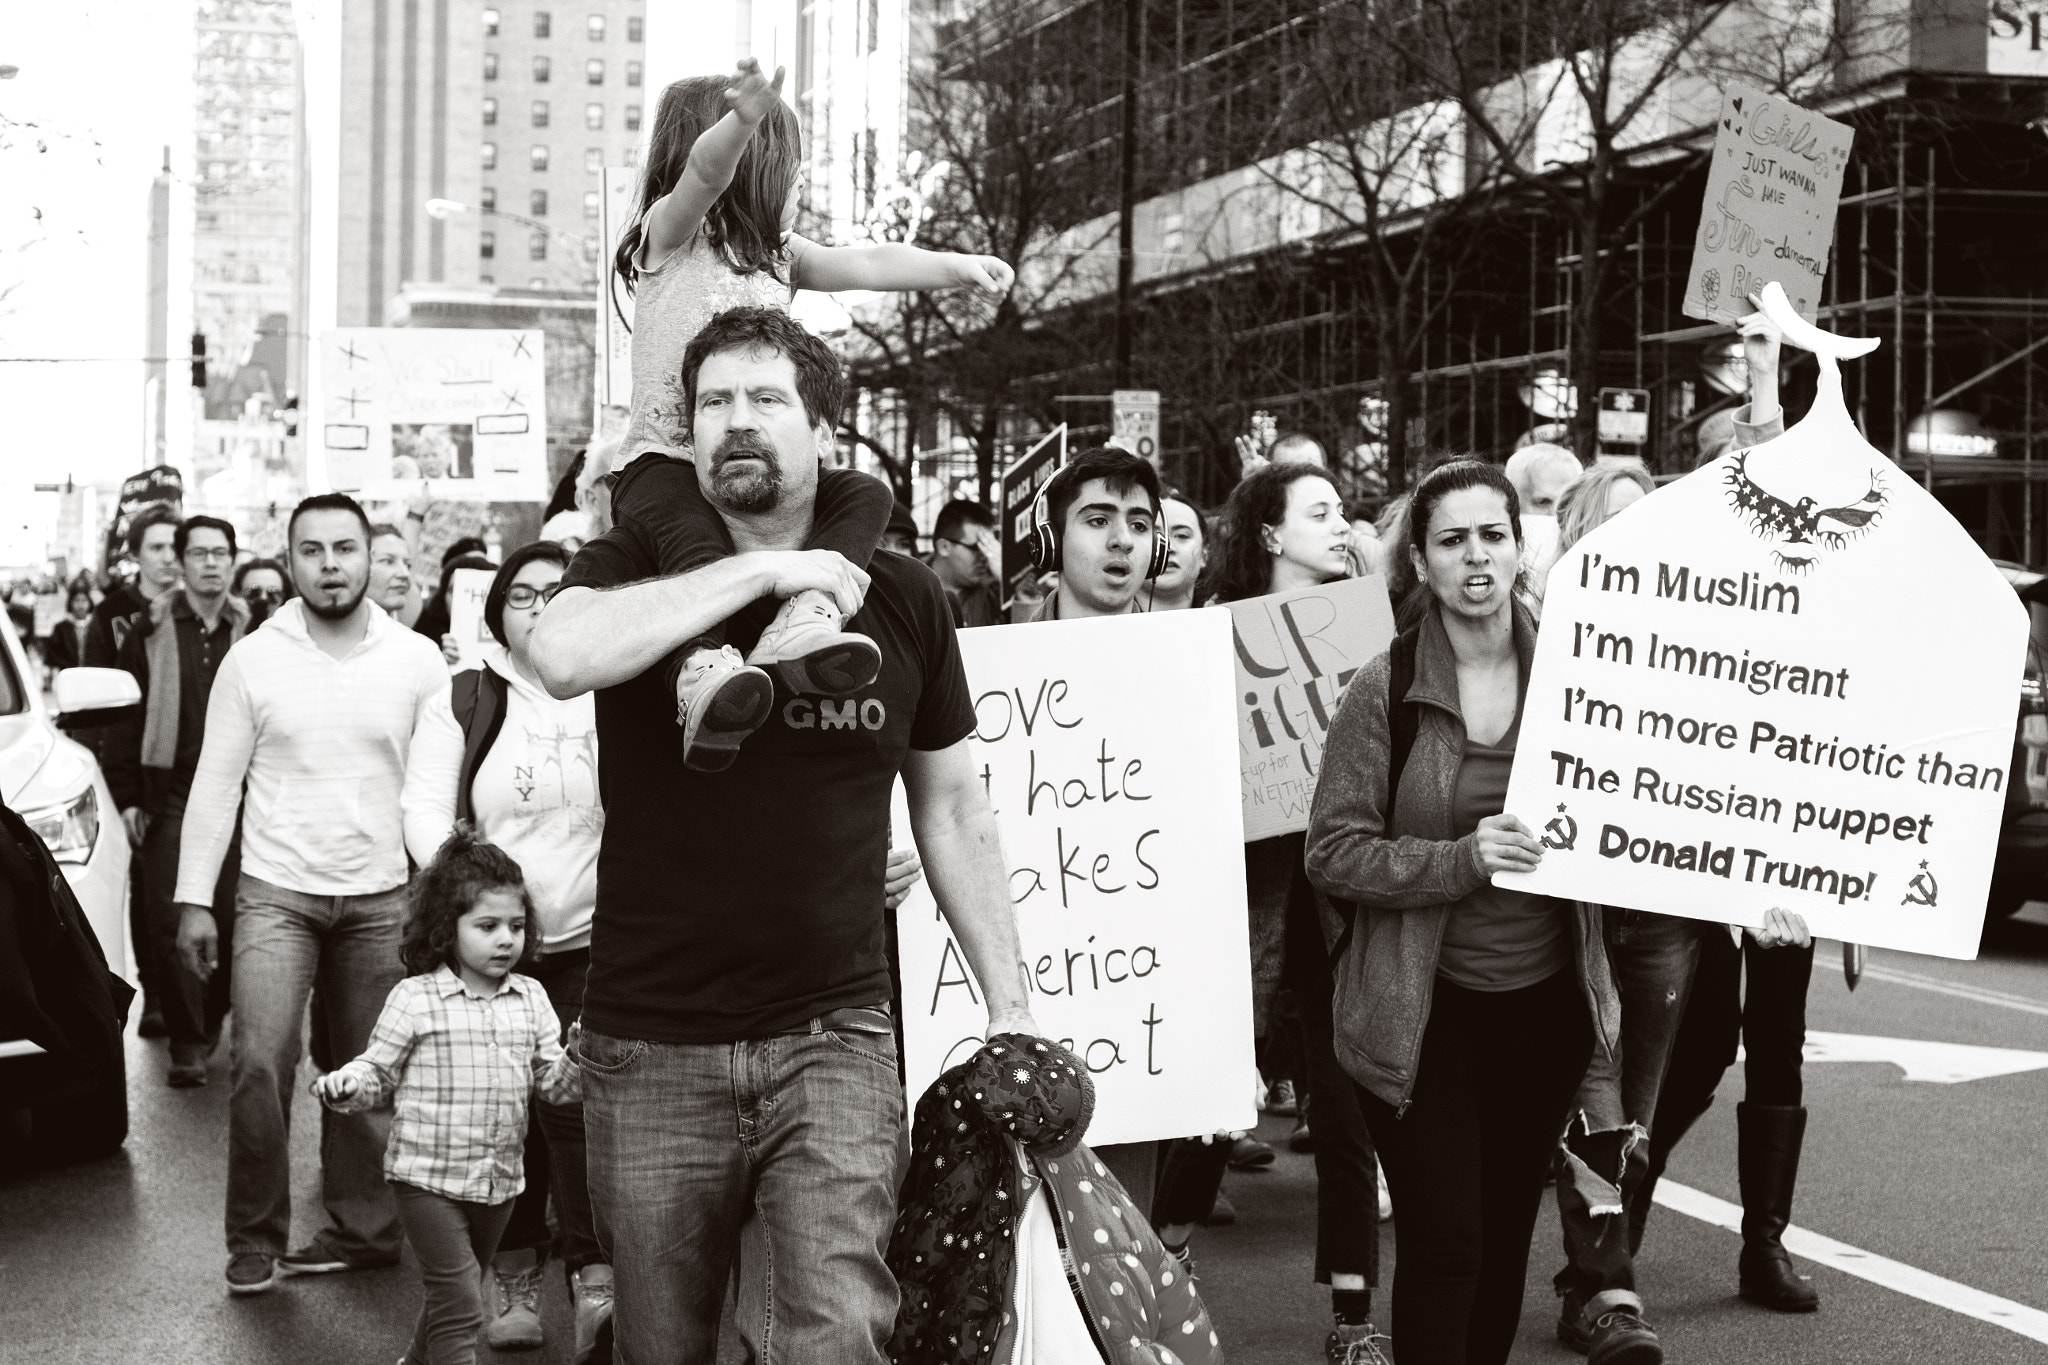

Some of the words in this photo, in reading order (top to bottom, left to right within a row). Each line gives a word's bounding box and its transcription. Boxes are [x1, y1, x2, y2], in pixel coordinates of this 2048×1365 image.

[1750, 102, 1820, 161] Girls
[1742, 151, 1777, 177] JUST
[1779, 165, 1817, 198] WANNA
[1761, 184, 1788, 205] HAVE
[1580, 553, 1640, 595] I'm
[1655, 562, 1800, 615] Muslim
[1572, 621, 1633, 665] I'm
[1647, 633, 1849, 700] Immigrant
[782, 698, 886, 731] GMO
[968, 679, 1083, 743] ove
[1564, 687, 1623, 732] I'm
[1637, 709, 1738, 749] more
[1749, 721, 1906, 779] Patriotic
[1917, 752, 2003, 793] than
[1027, 738, 1152, 816] hate
[1253, 775, 1316, 806] NEITHE
[1550, 750, 1620, 794] The
[1633, 767, 1782, 824] Russian
[1792, 801, 1934, 845] puppet
[1598, 824, 1735, 879] Donald
[1743, 848, 1878, 905] Trump!
[930, 935, 1161, 1016] Aerica
